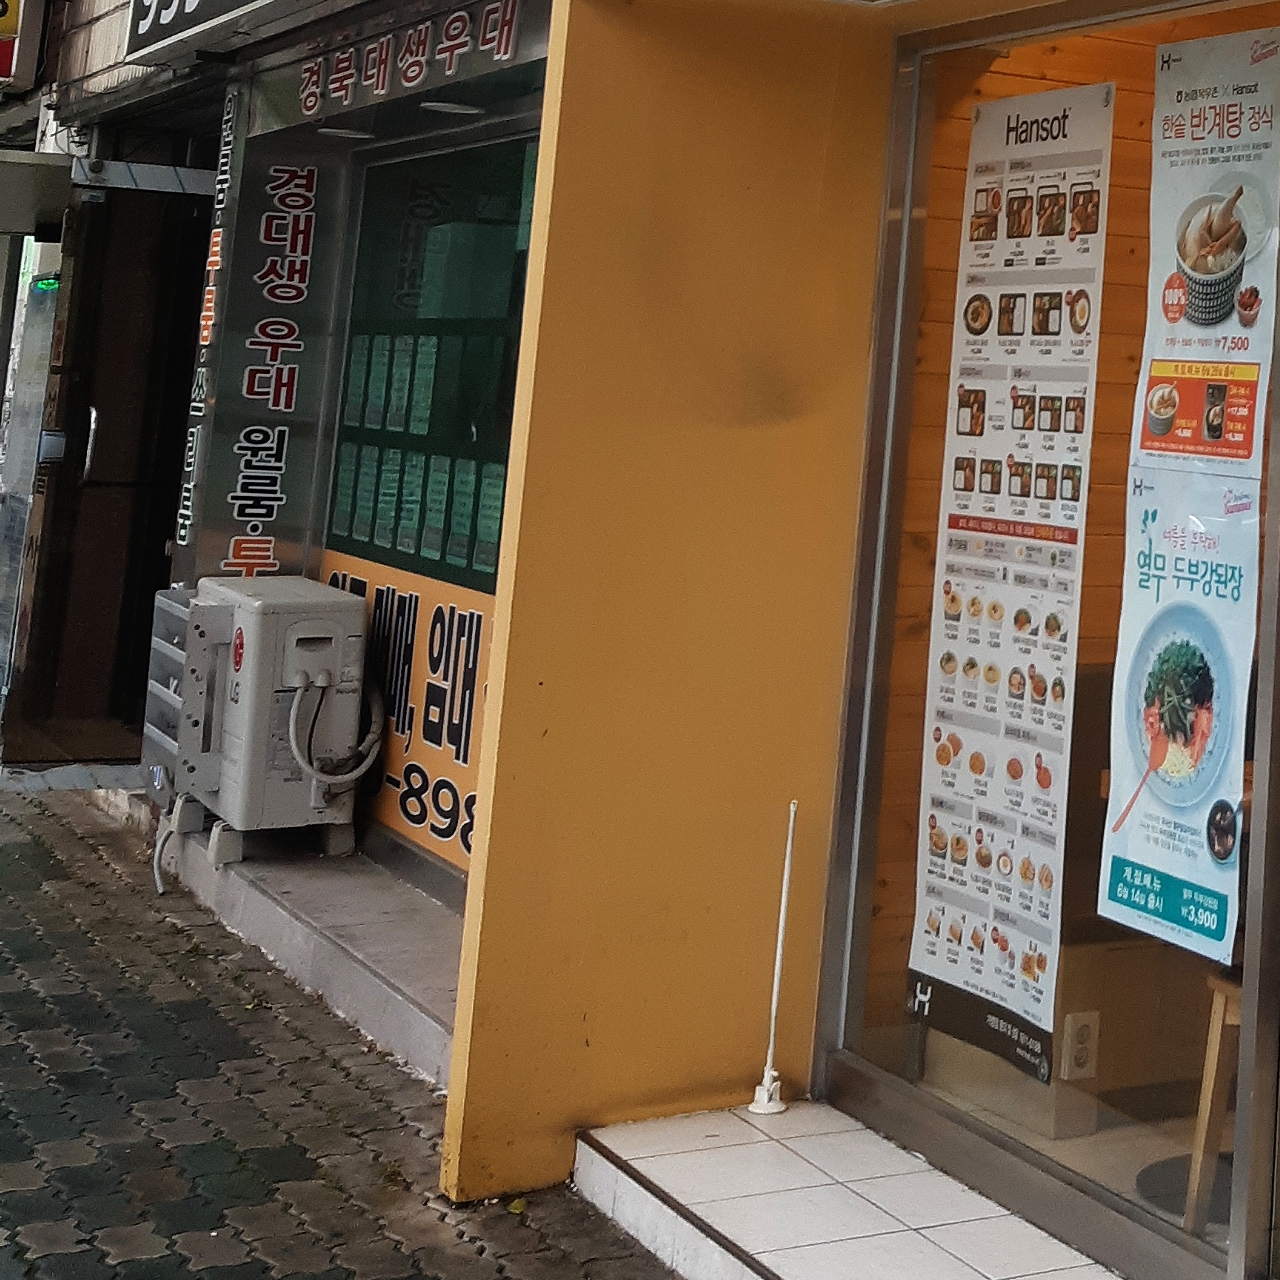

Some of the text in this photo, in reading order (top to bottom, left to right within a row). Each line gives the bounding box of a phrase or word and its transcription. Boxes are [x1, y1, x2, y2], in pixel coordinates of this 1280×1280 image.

[1006, 107, 1071, 146] Hansot
[1162, 102, 1274, 141] 한솥 반계탕 정식
[254, 166, 317, 303] 경대생
[242, 317, 303, 412] 우대
[1137, 538, 1167, 604] 열무
[1172, 557, 1244, 602] 두부강된장
[422, 603, 484, 767] 임대
